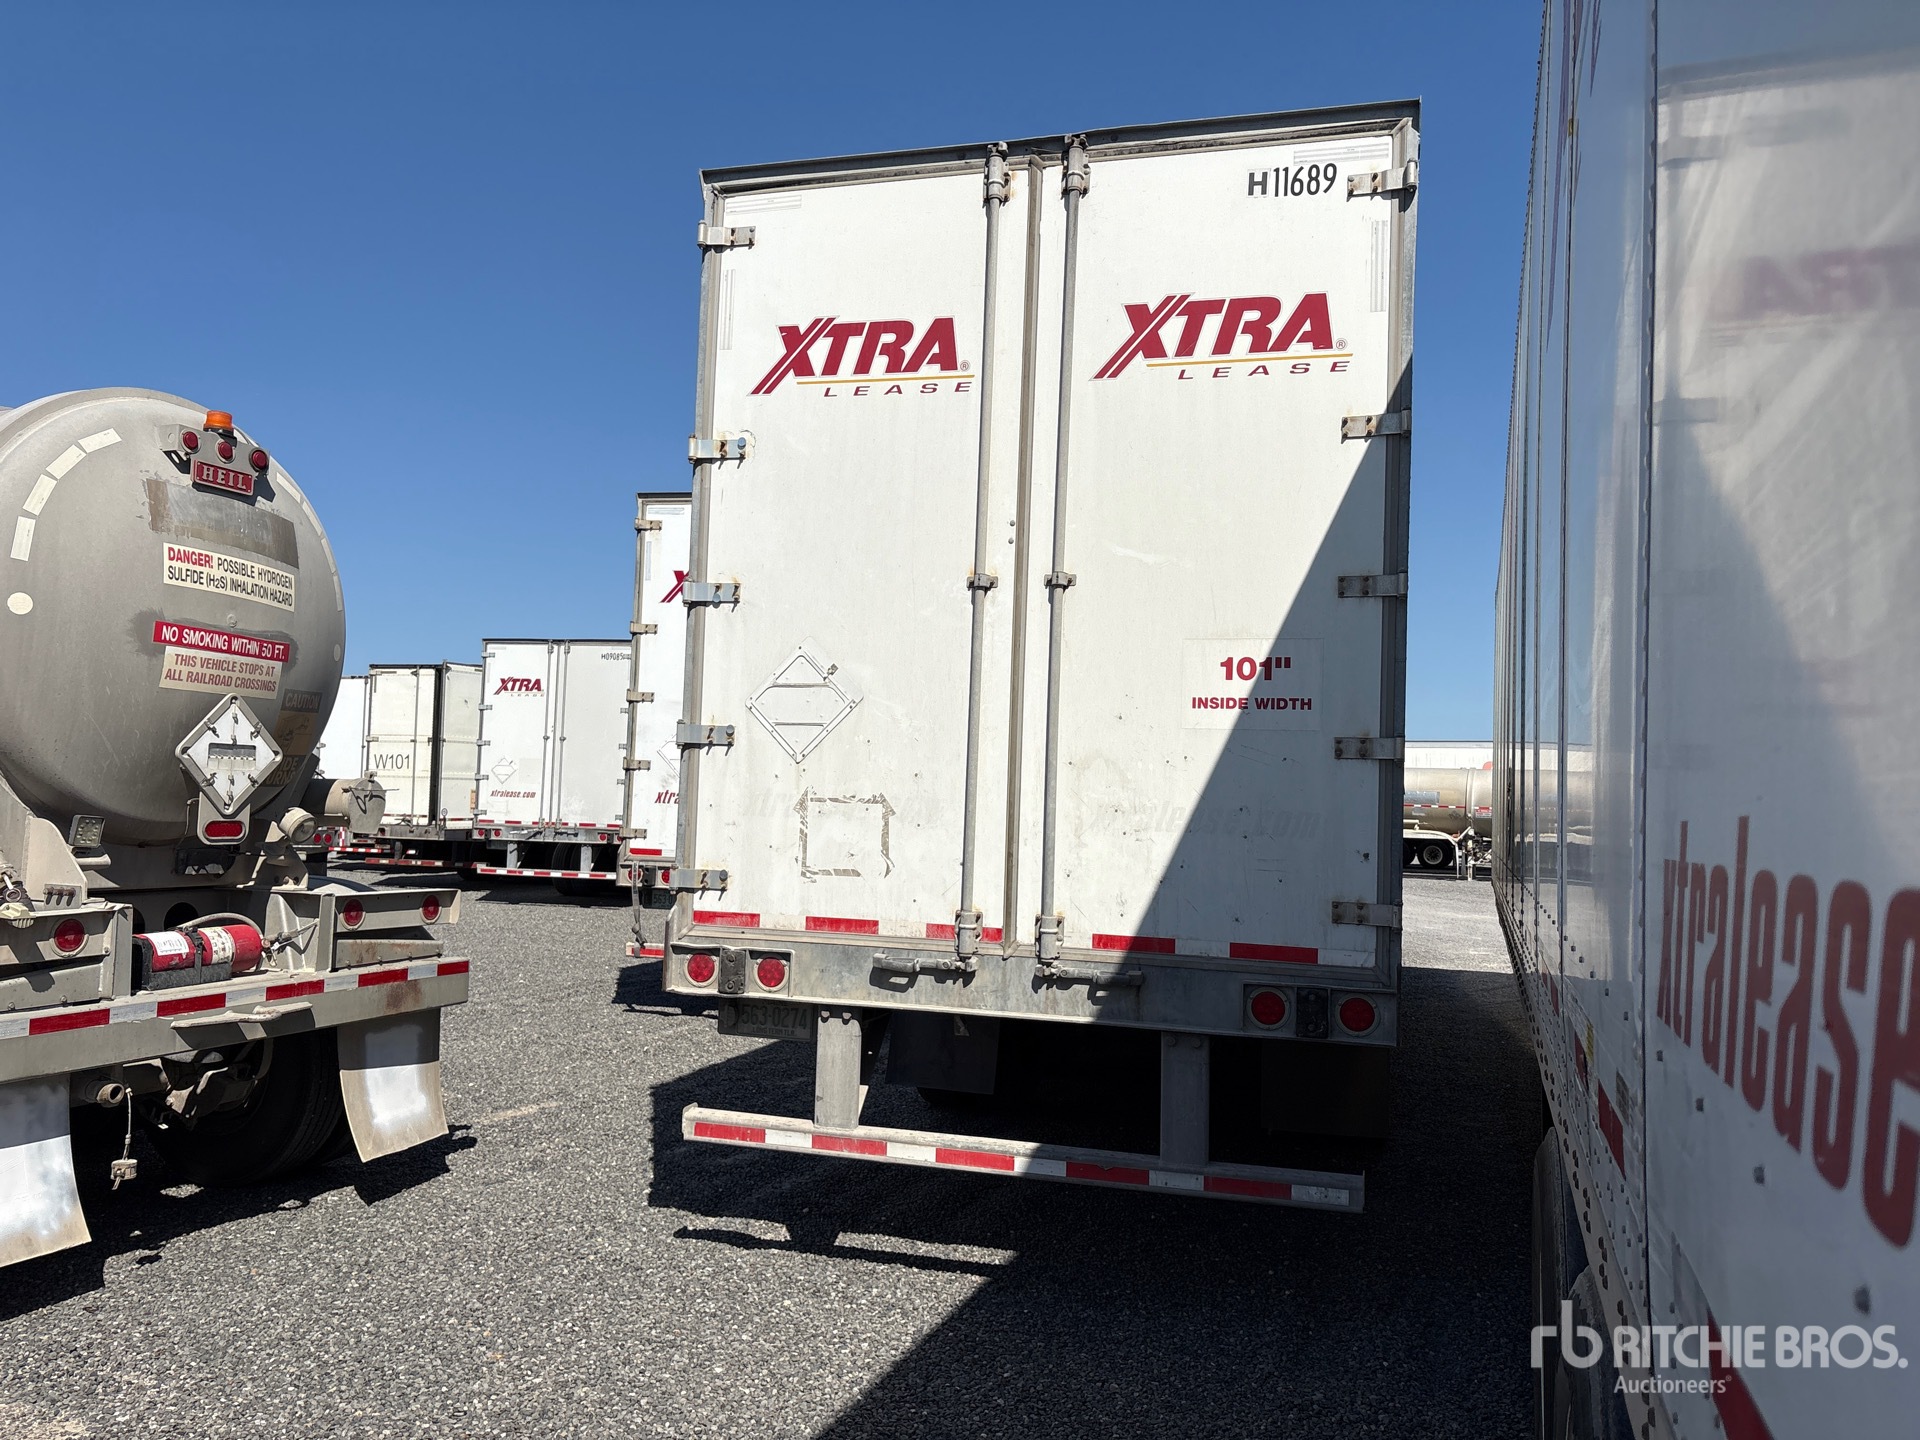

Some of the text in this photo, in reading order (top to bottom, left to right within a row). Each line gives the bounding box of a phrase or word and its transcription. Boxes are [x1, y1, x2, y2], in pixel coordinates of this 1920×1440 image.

[1247, 162, 1337, 197] H11689
[1093, 292, 1333, 380] XTRA
[750, 317, 958, 395] XTRA
[1177, 360, 1350, 380] LEASE
[823, 381, 972, 397] LEASE
[202, 465, 246, 489] HEIL
[167, 546, 293, 590] DANGER! POSSIBLE HYDROGEN
[167, 565, 204, 586] SULFIDE
[229, 577, 269, 600] INHALATION
[269, 588, 293, 607] HAZARD
[161, 625, 285, 660] NO SMOKING WITHIN 50 FT.
[174, 653, 276, 678] THIS VEHICLE STOPS AT
[1220, 656, 1292, 681] 101"
[164, 668, 277, 692] ALL RAILROAD CROSSINGS
[493, 676, 542, 695] XTRA
[285, 692, 320, 710] CAUTION
[1192, 697, 1312, 710] INSIDE WIDTH
[373, 753, 410, 770] W101
[490, 789, 536, 799] xtralease.com
